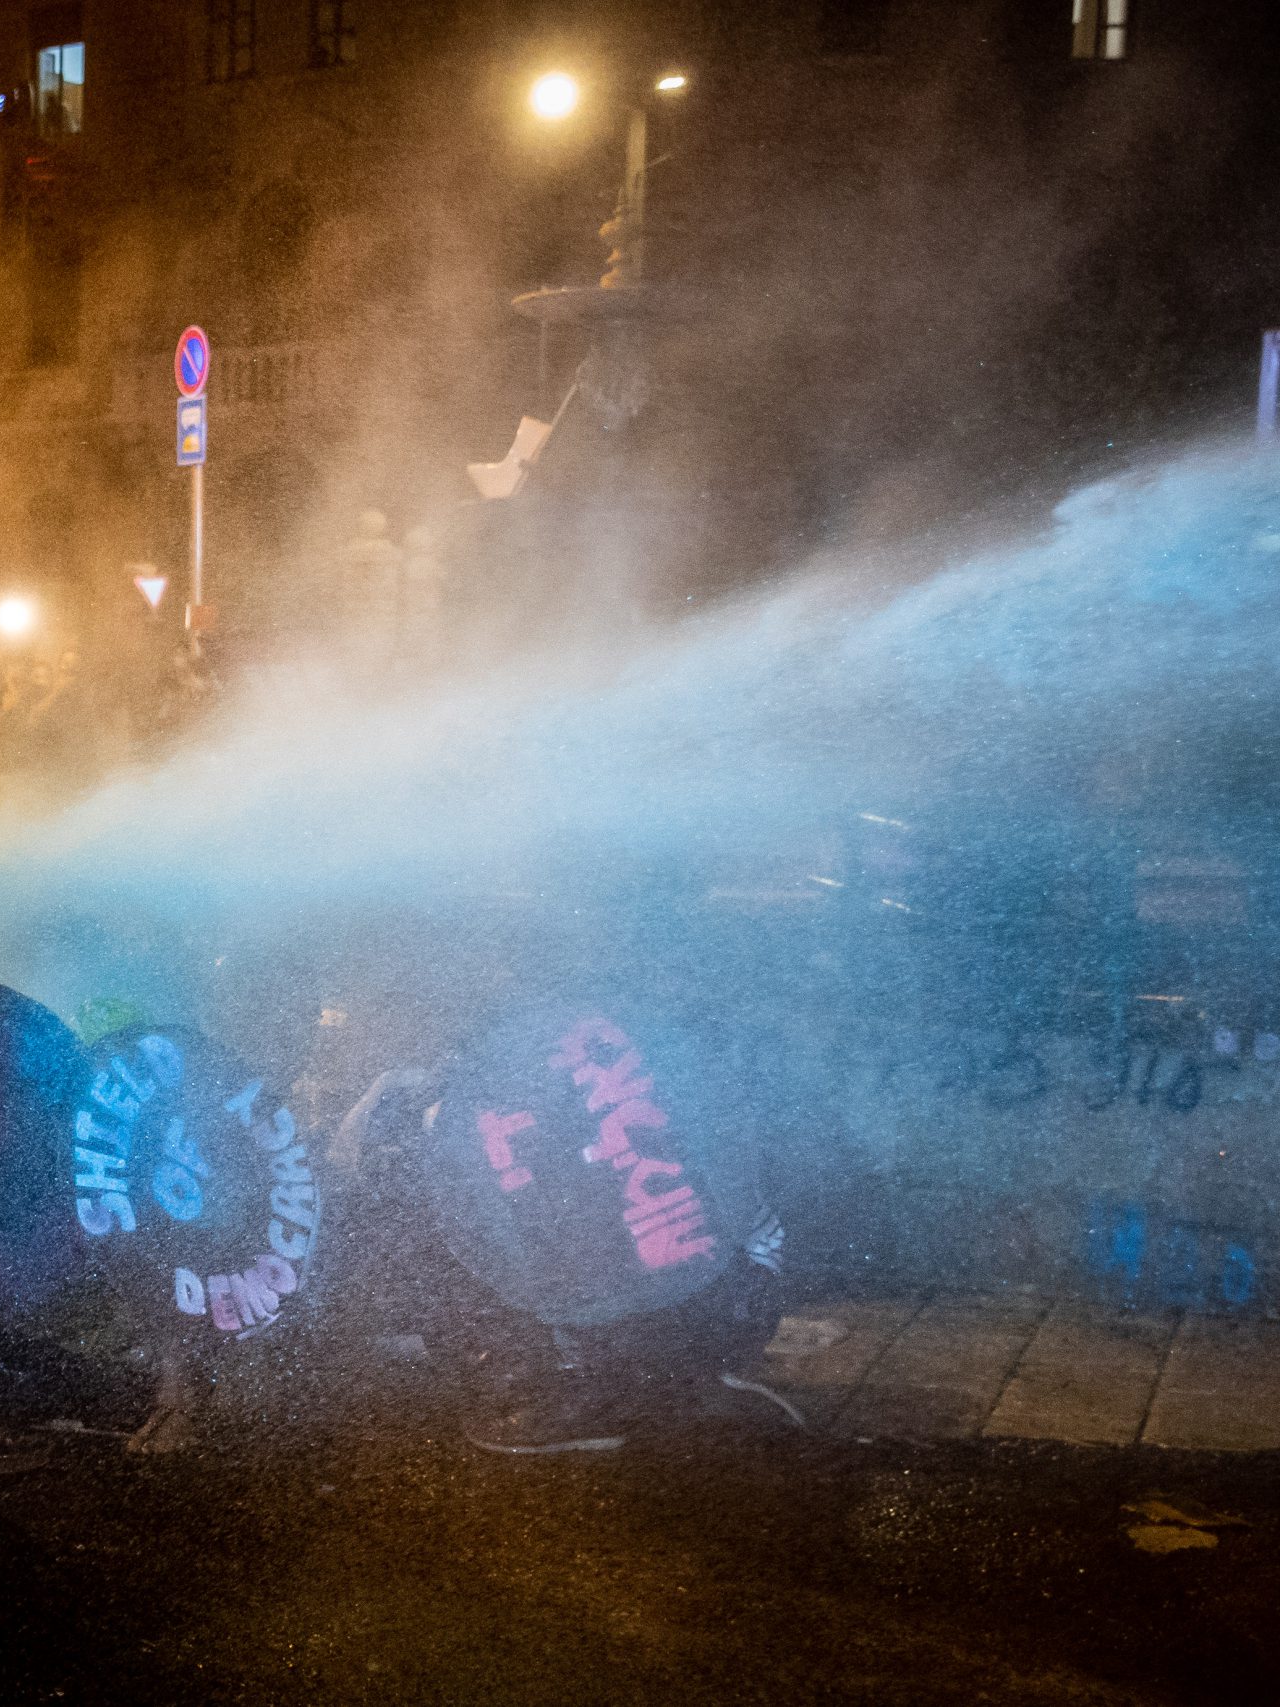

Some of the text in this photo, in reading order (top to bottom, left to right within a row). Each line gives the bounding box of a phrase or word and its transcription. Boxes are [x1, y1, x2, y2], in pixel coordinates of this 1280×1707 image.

[74, 1034, 185, 1236] SHIELD
[152, 1117, 211, 1222] OF
[174, 1079, 316, 1332] DEMOCRACY
